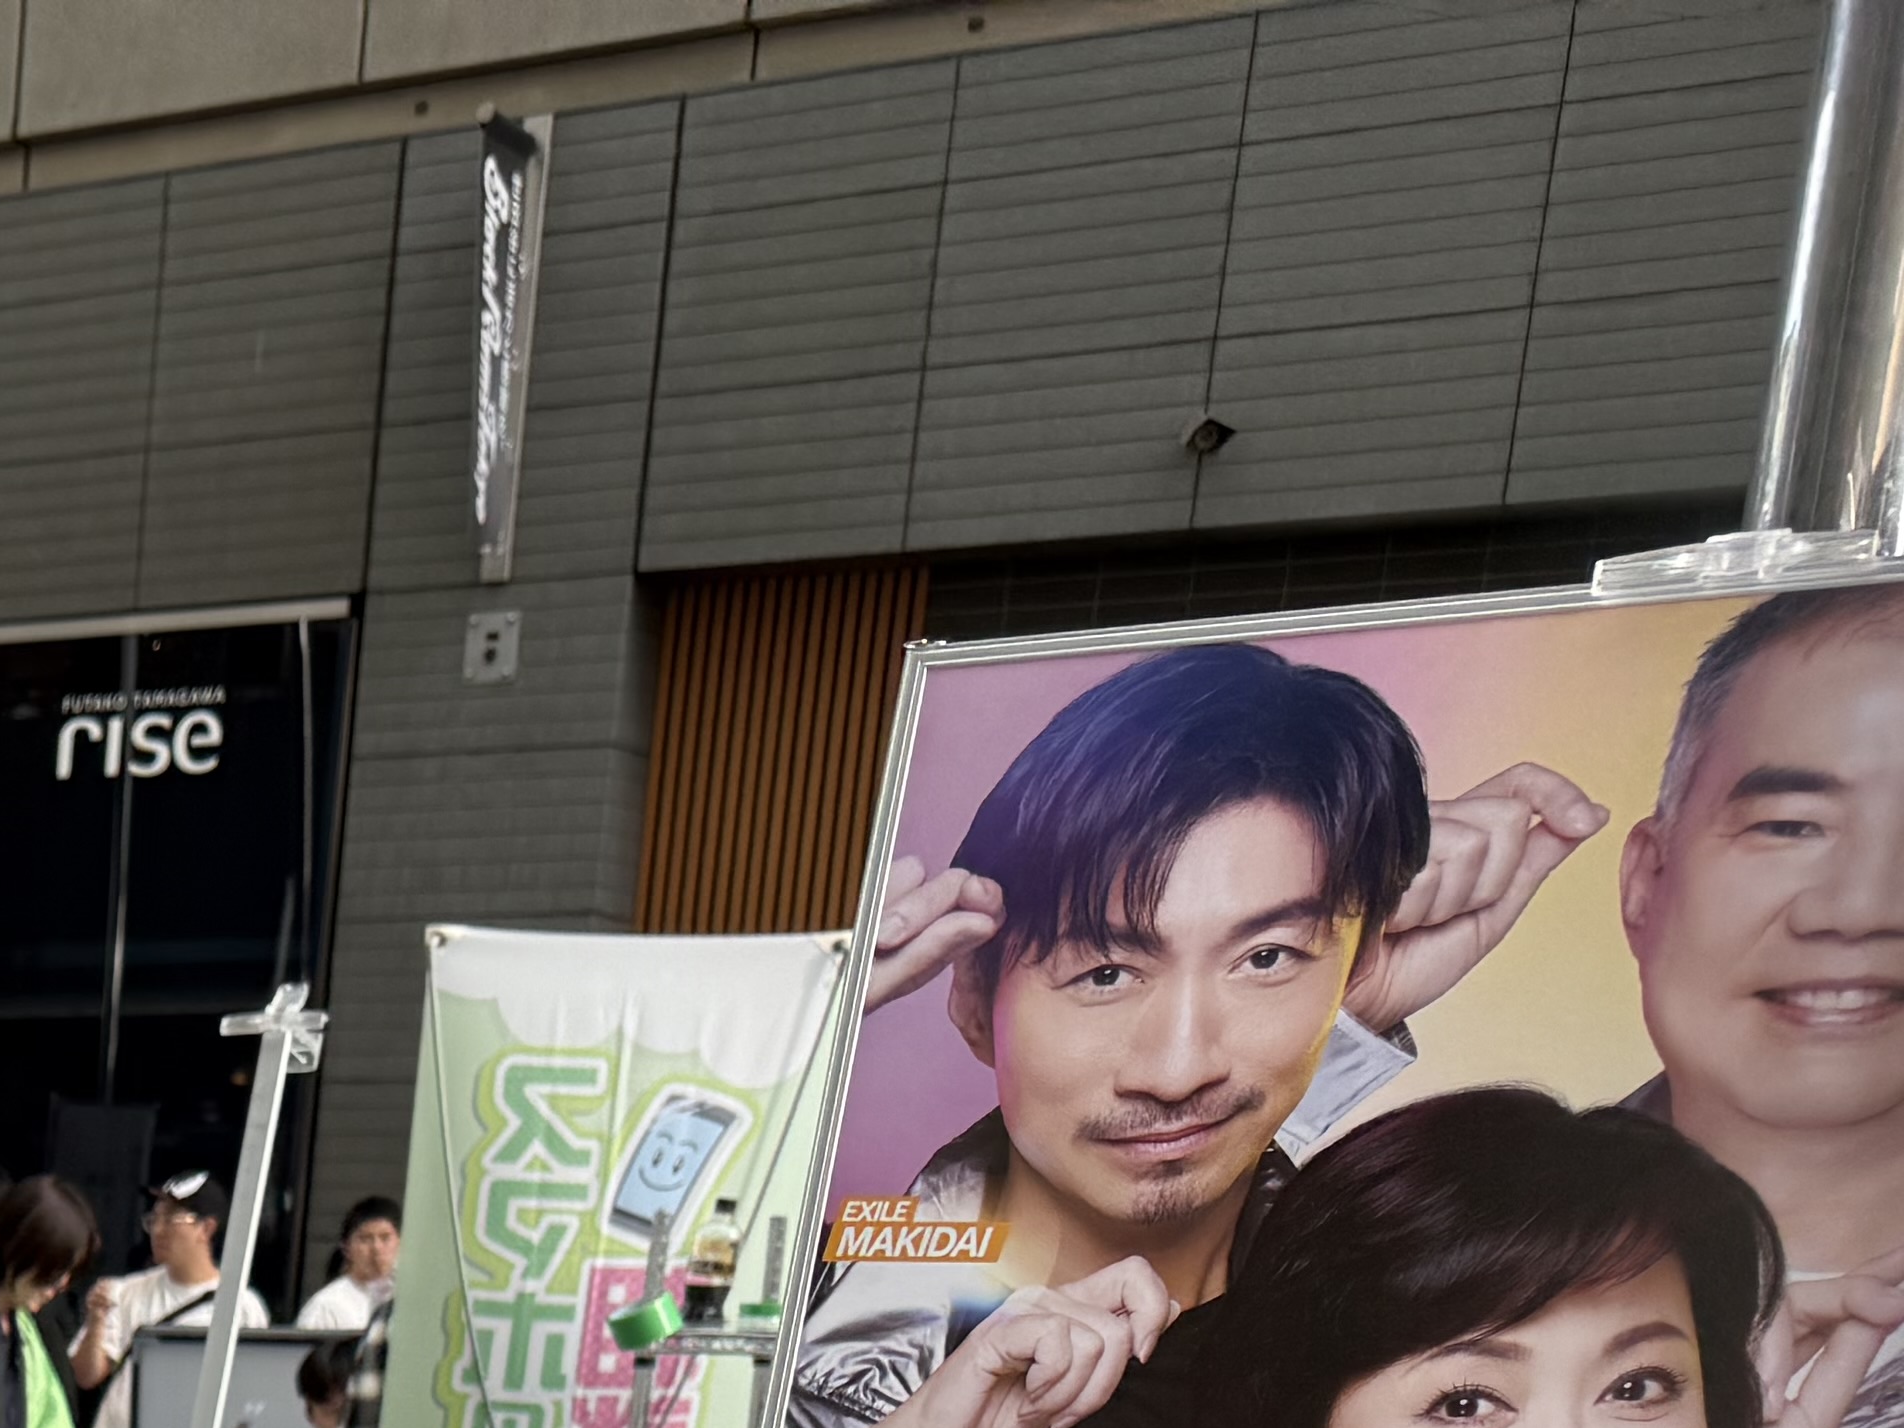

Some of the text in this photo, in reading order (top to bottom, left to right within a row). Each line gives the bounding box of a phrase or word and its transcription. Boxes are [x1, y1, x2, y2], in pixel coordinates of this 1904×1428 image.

[56, 708, 223, 780] rise
[841, 1199, 911, 1223] EXILE
[835, 1225, 995, 1259] MAKIDAI
